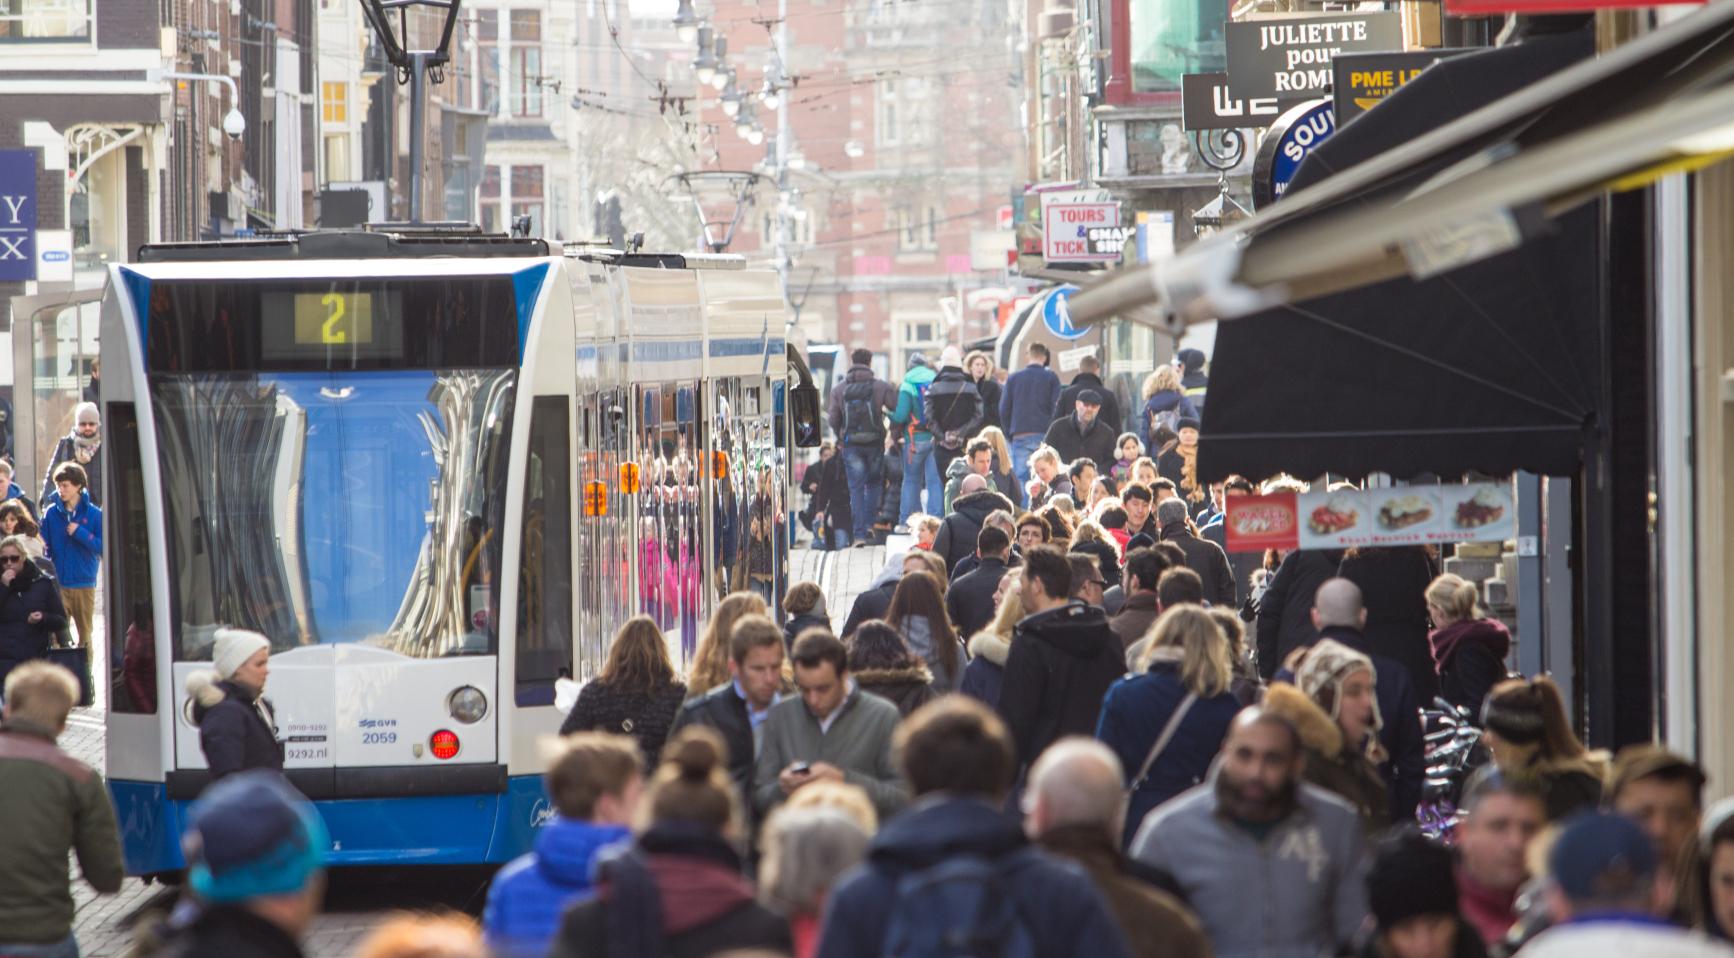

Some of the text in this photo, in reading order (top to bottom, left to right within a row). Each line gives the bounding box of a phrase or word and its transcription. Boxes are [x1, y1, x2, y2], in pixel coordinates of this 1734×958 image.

[1260, 21, 1368, 50] JULIETTE
[1351, 70, 1394, 88] PME
[1060, 209, 1105, 223] TOURS
[1077, 225, 1087, 238] &
[321, 293, 345, 344] 2
[287, 724, 328, 732] 0900-9292
[362, 732, 397, 744] 2059
[288, 747, 328, 759] 9292.nl
